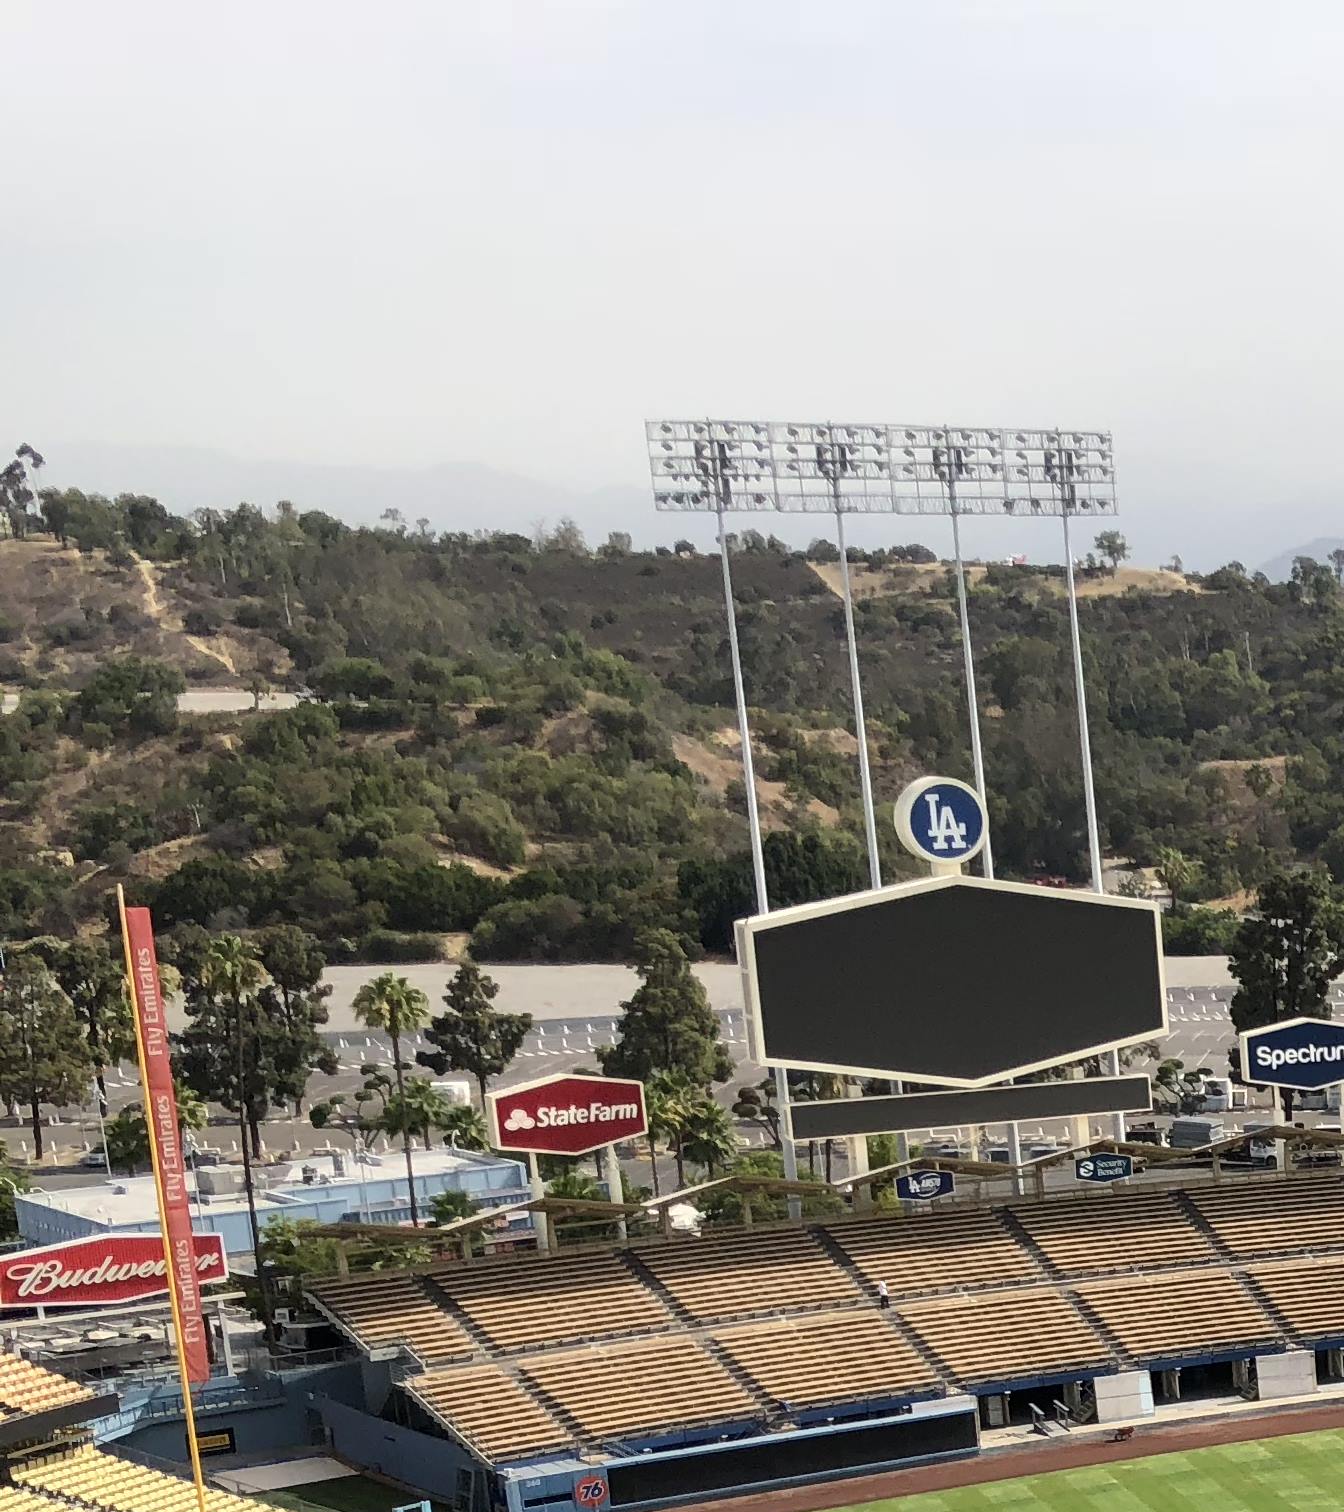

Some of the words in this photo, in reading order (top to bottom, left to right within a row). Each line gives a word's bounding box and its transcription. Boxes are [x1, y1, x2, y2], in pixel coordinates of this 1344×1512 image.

[924, 793, 967, 850] LA
[137, 947, 159, 1025] Emirates
[147, 1027, 165, 1057] Fly
[156, 1094, 179, 1171] Emirates
[165, 1172, 183, 1201] Fly
[6, 1252, 220, 1297] Budweir
[175, 1239, 197, 1312] Emirates
[184, 1315, 200, 1344] Fly
[580, 1480, 604, 1501] 76
